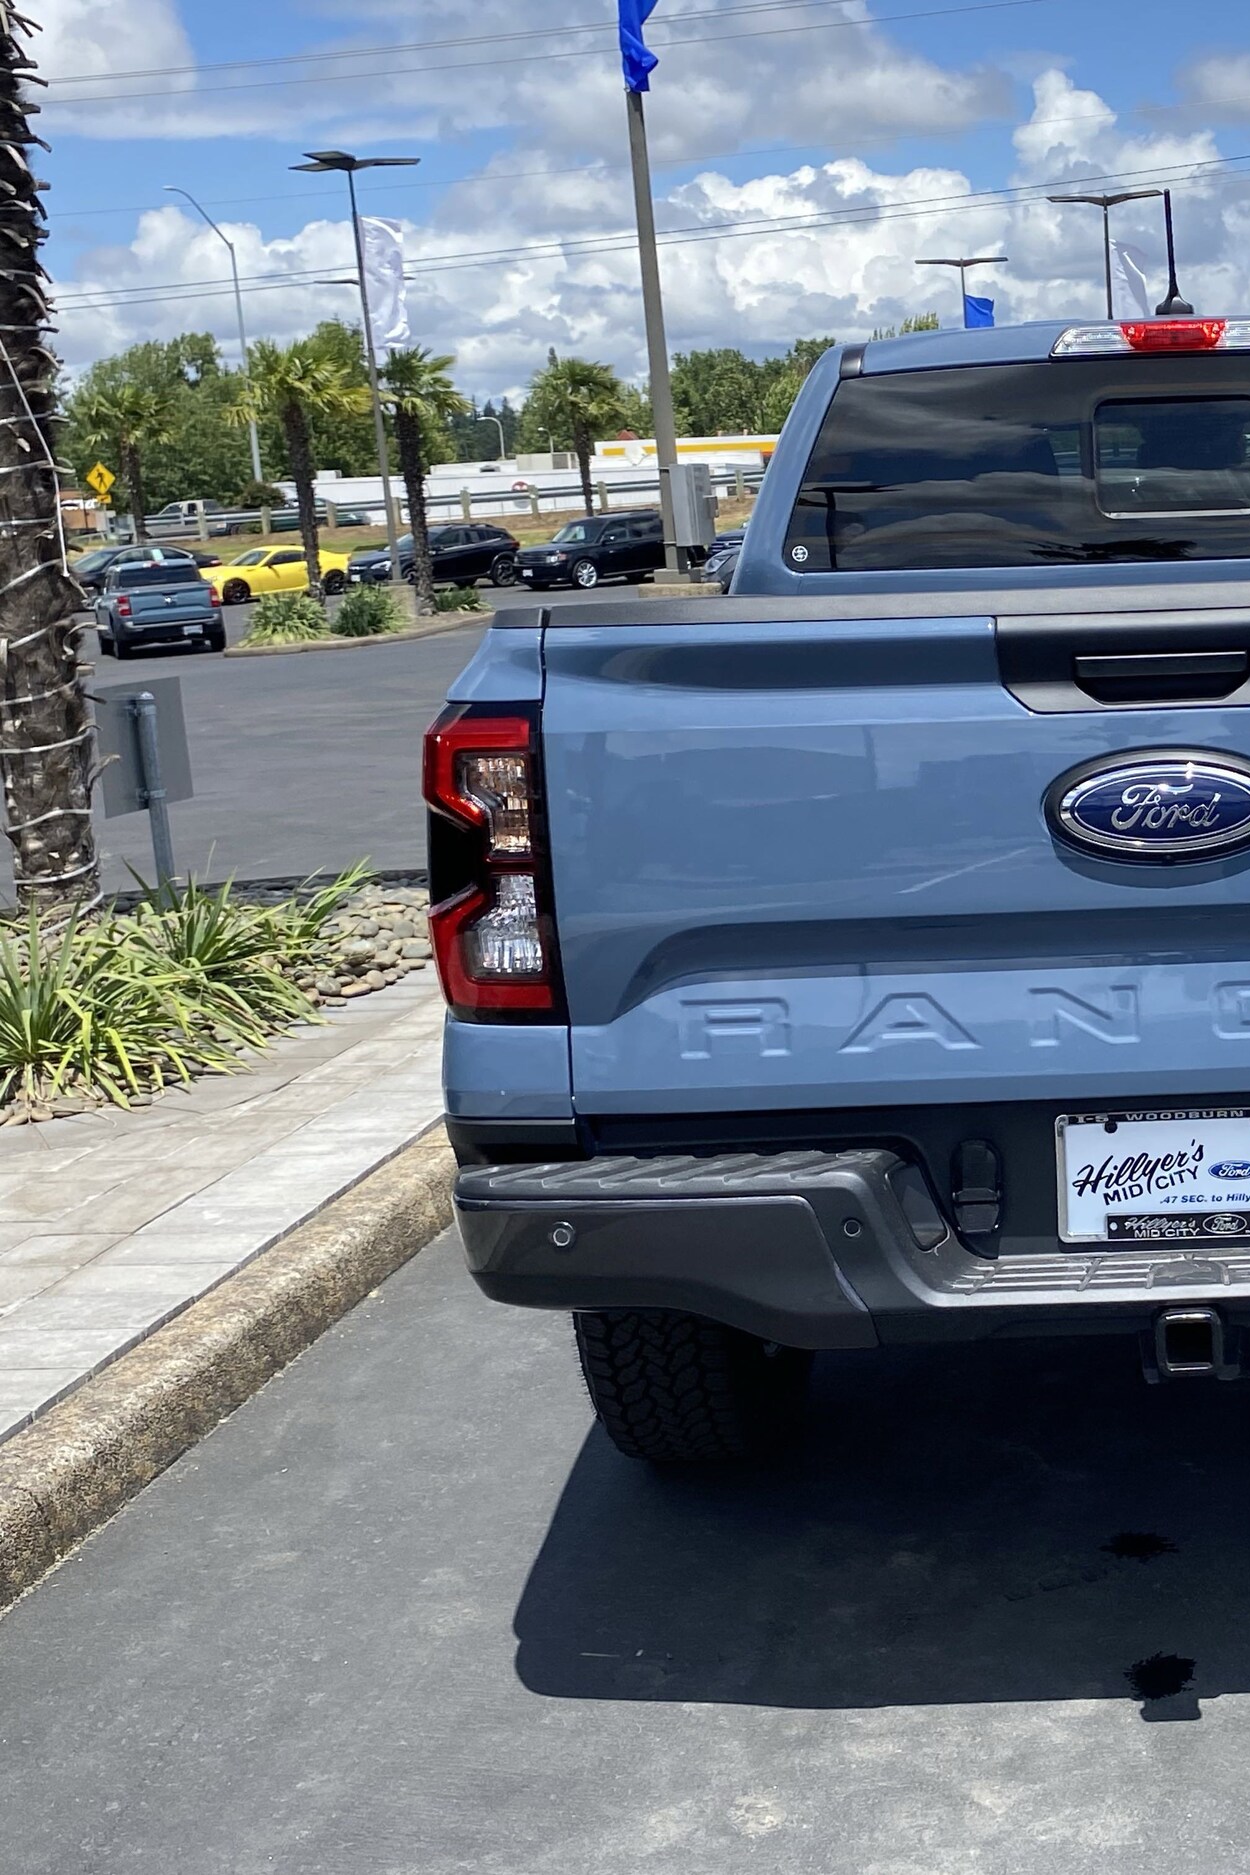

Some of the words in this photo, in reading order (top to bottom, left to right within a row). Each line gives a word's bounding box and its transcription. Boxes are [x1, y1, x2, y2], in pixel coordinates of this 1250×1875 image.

[1111, 784, 1221, 830] Ford
[1125, 1110, 1244, 1121] WOODBURN
[1072, 1138, 1204, 1198] Hillyer's
[1219, 1162, 1250, 1177] Ford
[1103, 1183, 1143, 1206] MID
[1155, 1165, 1199, 1190] CITY
[1180, 1193, 1207, 1203] SEC.
[1211, 1193, 1223, 1202] to
[1124, 1216, 1196, 1233] Hillyer's
[1211, 1216, 1239, 1231] Ford
[1134, 1228, 1161, 1238] MID
[1165, 1227, 1200, 1237] CITY
